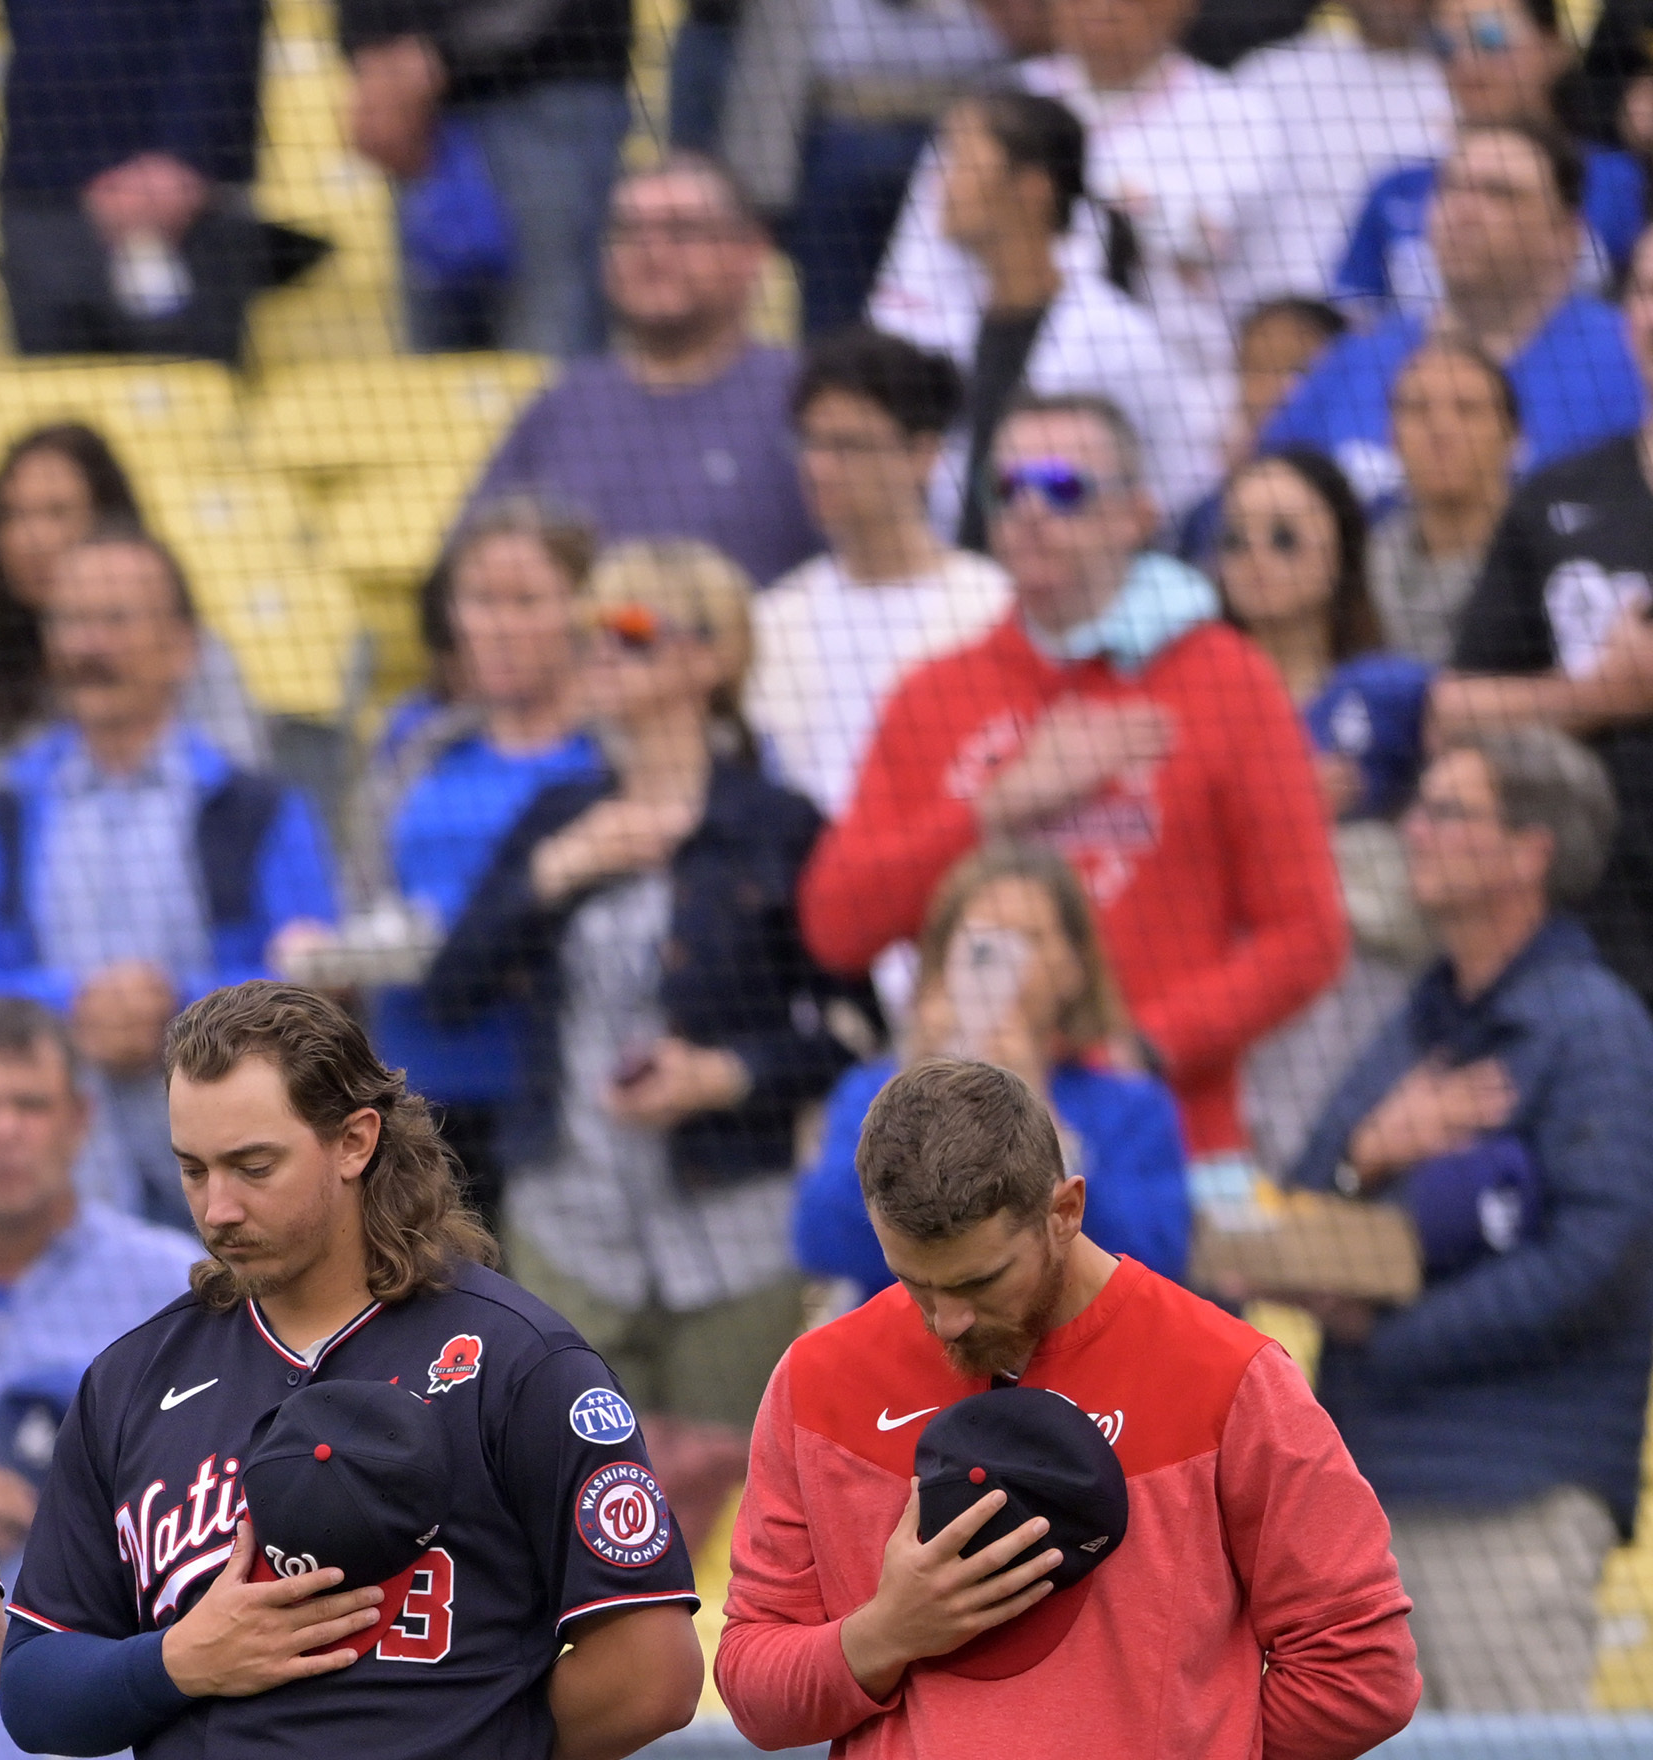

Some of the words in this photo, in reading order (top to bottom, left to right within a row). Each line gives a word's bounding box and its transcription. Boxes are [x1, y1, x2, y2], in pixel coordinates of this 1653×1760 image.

[433, 1366, 446, 1374] LEST
[455, 1365, 475, 1373] FORGET
[575, 1403, 632, 1435] TNL
[582, 1466, 663, 1511] WASHINGTON
[593, 1527, 669, 1563] NATIONALS
[376, 1548, 455, 1664] 3
